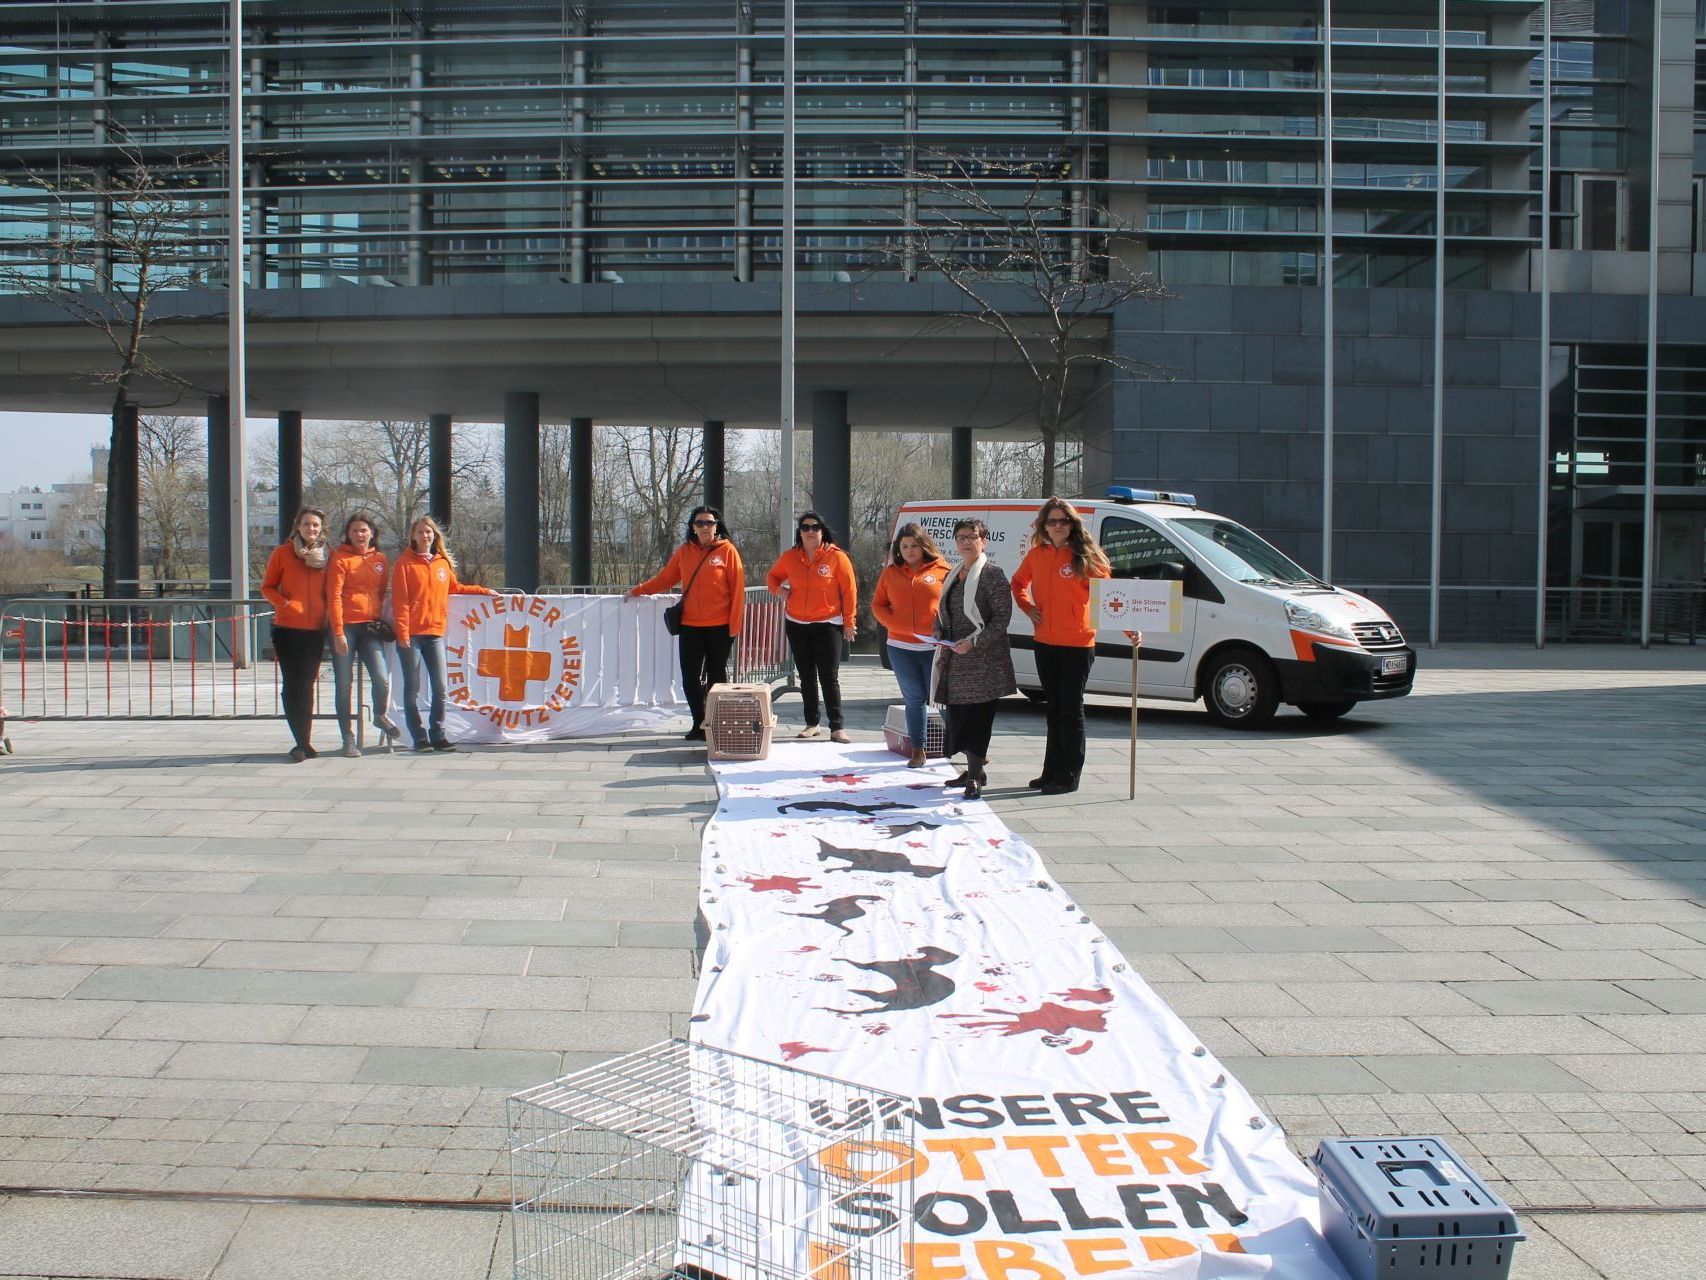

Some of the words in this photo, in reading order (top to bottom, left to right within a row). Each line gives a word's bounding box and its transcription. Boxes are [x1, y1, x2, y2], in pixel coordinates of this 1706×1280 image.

[460, 595, 561, 631] WIENER
[446, 635, 581, 730] TIERSCHUTZVEREIN
[809, 1090, 1171, 1131] UNSERE
[820, 1132, 1211, 1185] OTTER
[829, 1182, 1249, 1237] SOLLEN
